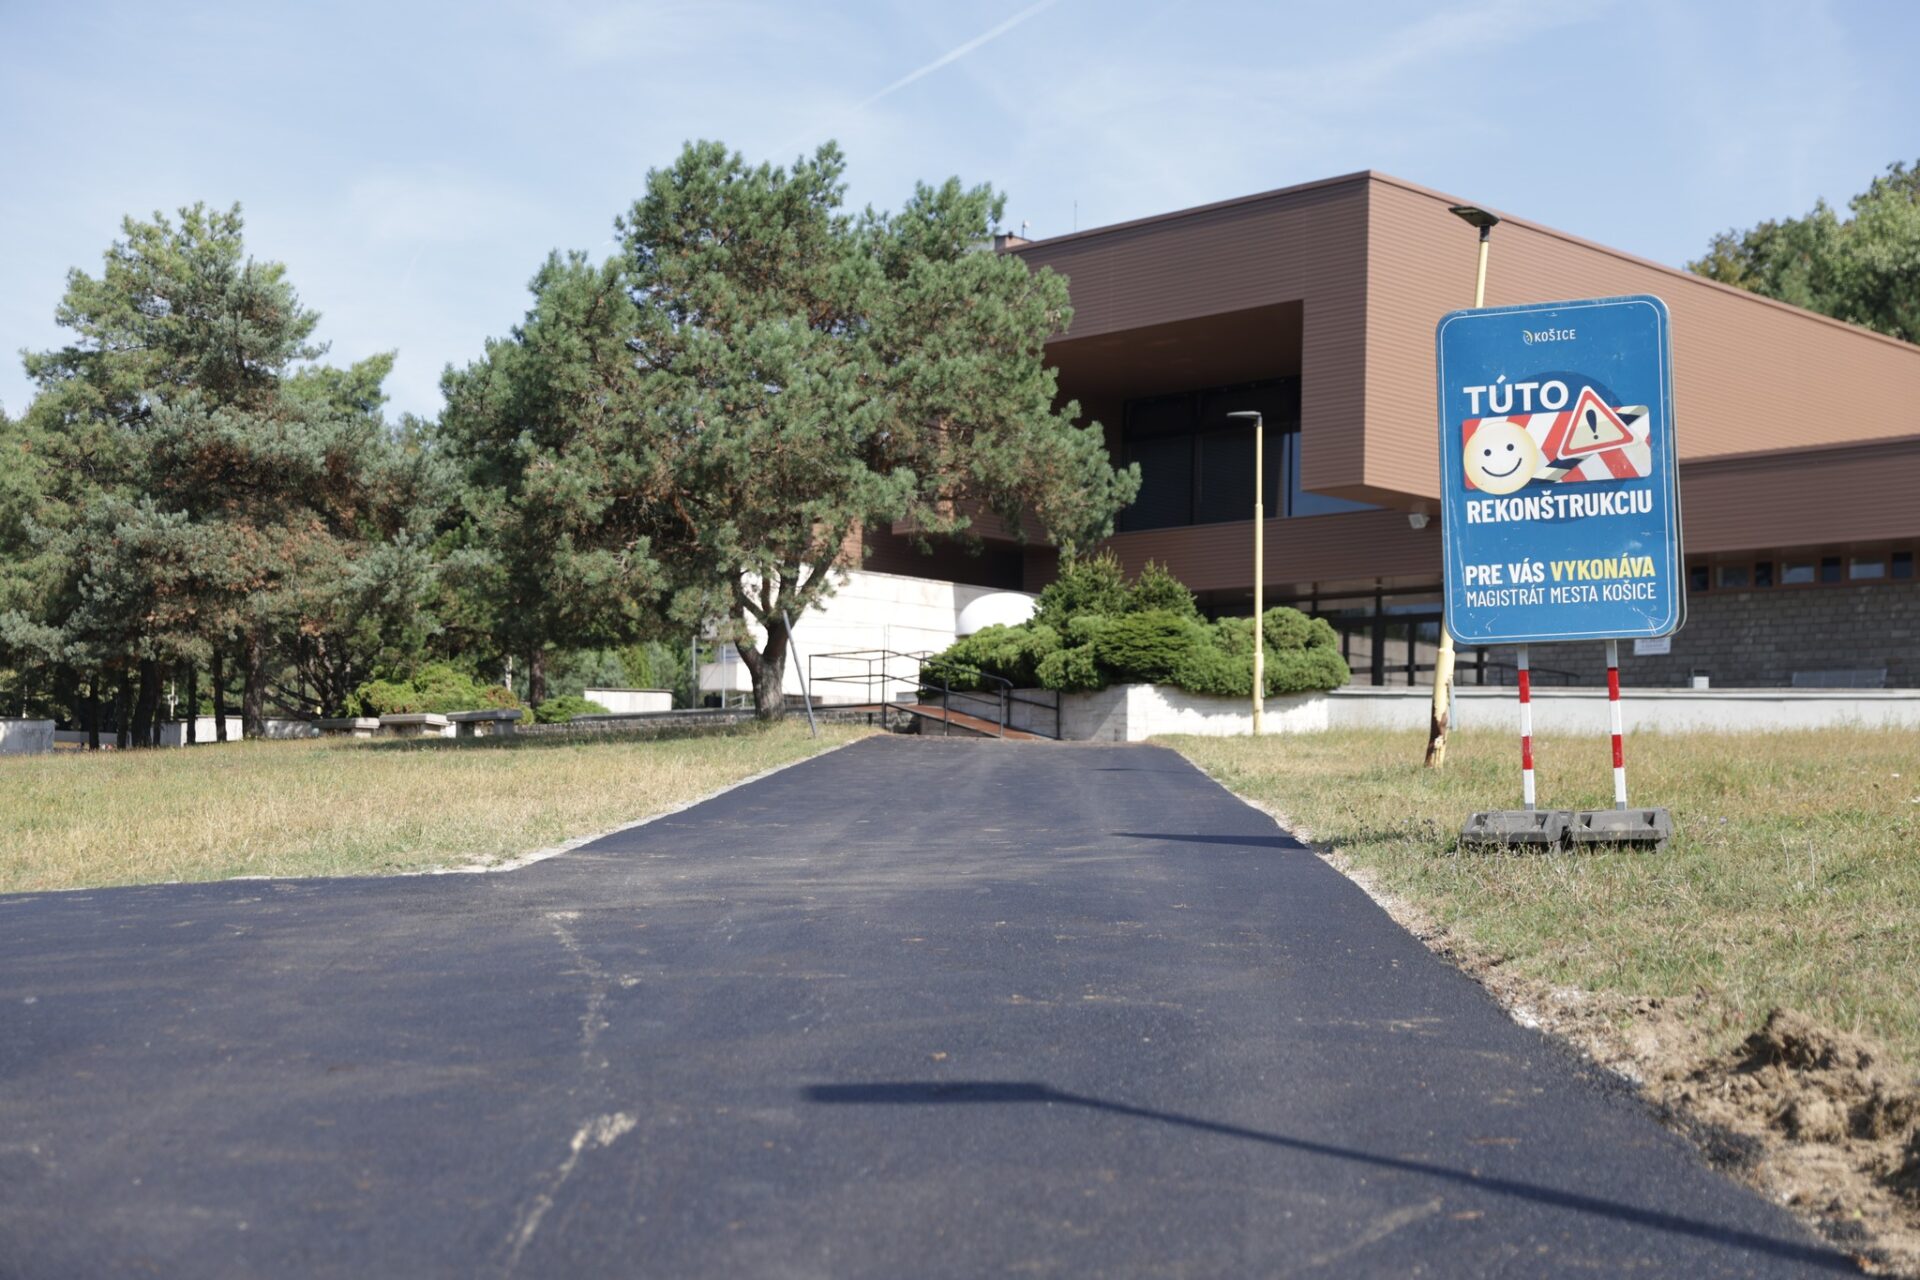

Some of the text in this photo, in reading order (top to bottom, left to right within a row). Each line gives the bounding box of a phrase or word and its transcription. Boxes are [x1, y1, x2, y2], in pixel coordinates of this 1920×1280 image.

[1534, 328, 1576, 342] KOŠICE
[1463, 374, 1569, 415] TÚTO
[1467, 489, 1652, 524] REKONŠTRUKCIU
[1465, 552, 1656, 586] PRE VÁS VYKONÁVA
[1466, 580, 1656, 608] MAGISTRÁT MESTA KOŠICE
